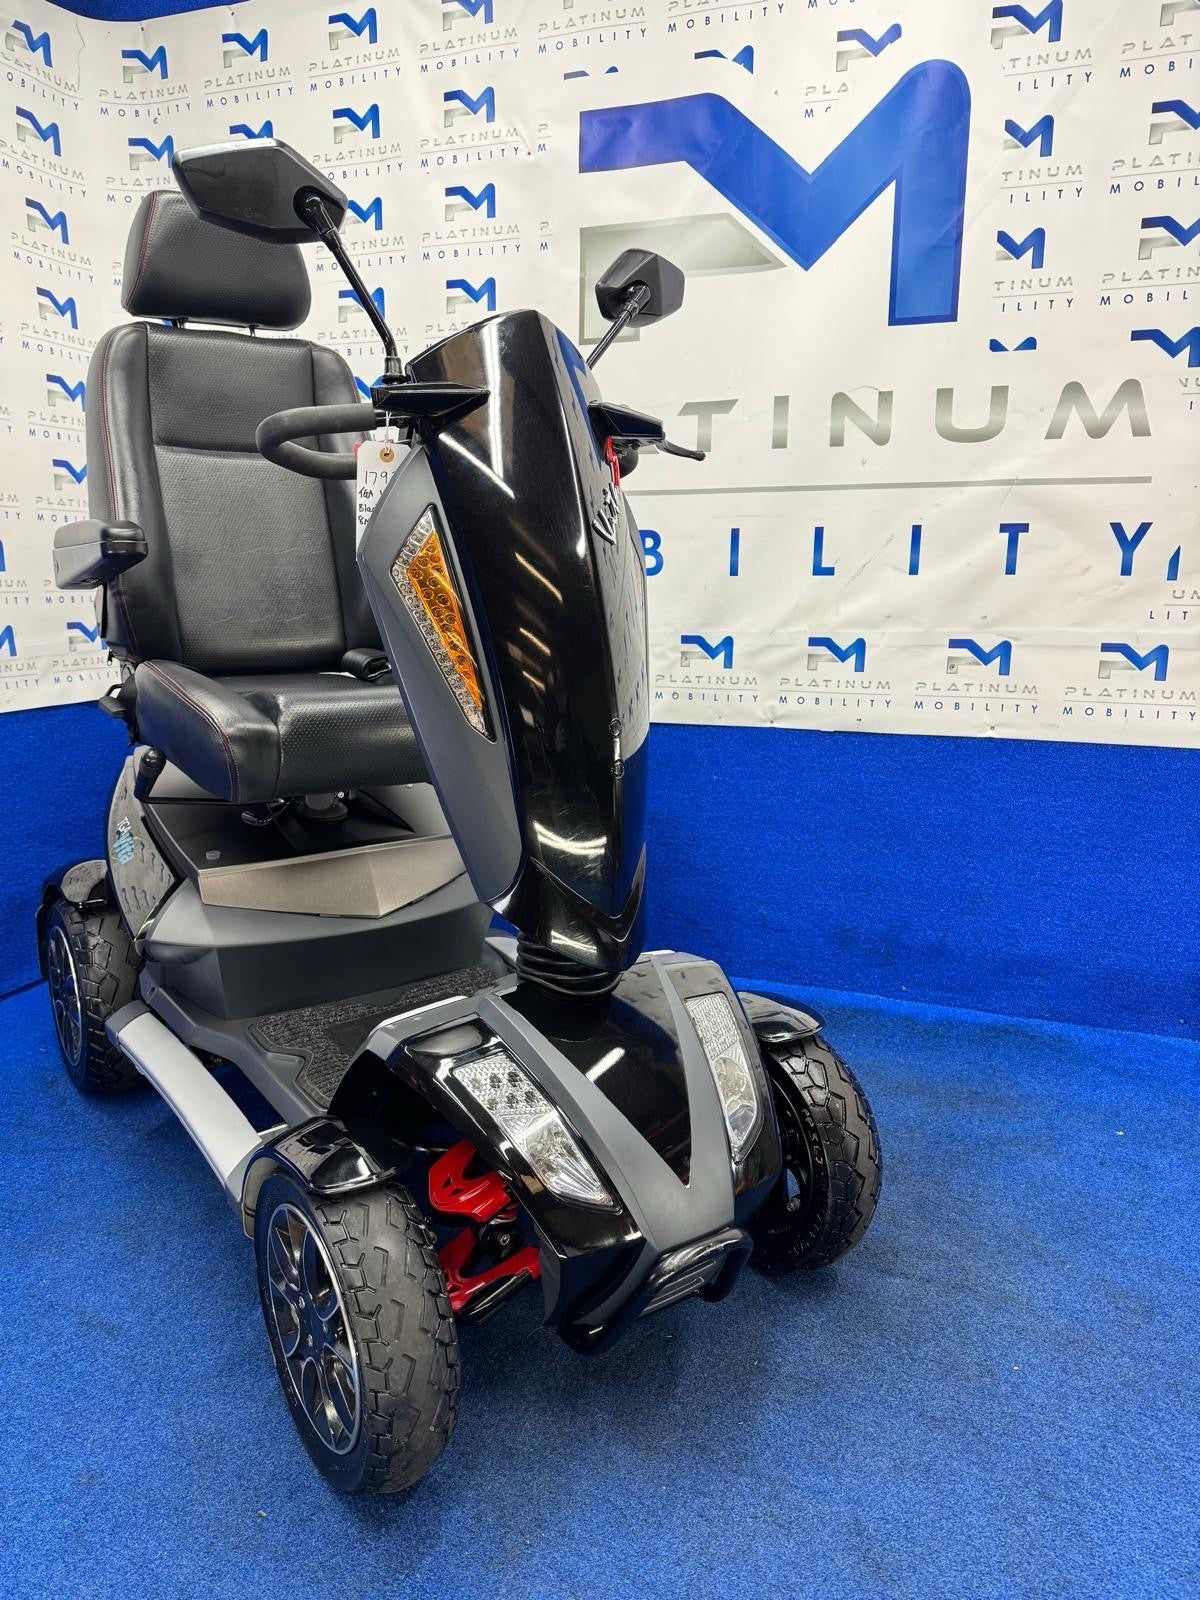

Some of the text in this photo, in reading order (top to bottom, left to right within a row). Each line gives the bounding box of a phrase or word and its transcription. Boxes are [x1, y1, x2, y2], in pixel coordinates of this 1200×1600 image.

[538, 7, 646, 33] PLATINUM
[667, 3, 785, 33] MOBILITY
[420, 27, 518, 54] PLATINUM
[538, 28, 647, 54] MOBILITY
[309, 47, 400, 72] PLATINUM
[420, 48, 519, 73] MOBILITY
[204, 66, 291, 89] PLATINUM
[310, 67, 401, 92] MOBILITY
[98, 84, 189, 100] PLATINUM
[206, 86, 294, 108] MOBILITY
[100, 102, 191, 116] MOBILITY
[420, 127, 519, 149] PLATINUM
[421, 147, 519, 168] MOBILITY
[2, 158, 86, 198] MOBILITY
[422, 223, 520, 242] PLATINUM
[11, 232, 92, 266] PLATINUM
[422, 244, 520, 261] MOBILITY
[13, 251, 94, 282] MOBILITY
[317, 255, 406, 272] MOILITY
[640, 379, 1152, 453] TINUM
[364, 470, 396, 485] 179
[358, 504, 377, 513] Bla
[655, 675, 759, 687] PLATINUM
[779, 678, 892, 691] PLATINUM
[915, 681, 1039, 695] PLATINUM
[655, 692, 759, 704] MOBILITY
[778, 695, 892, 708] MOBILITY
[1064, 687, 1197, 701] PLATINUM
[914, 700, 1038, 714] MOBILITY
[1062, 705, 1196, 721] MOBILITY
